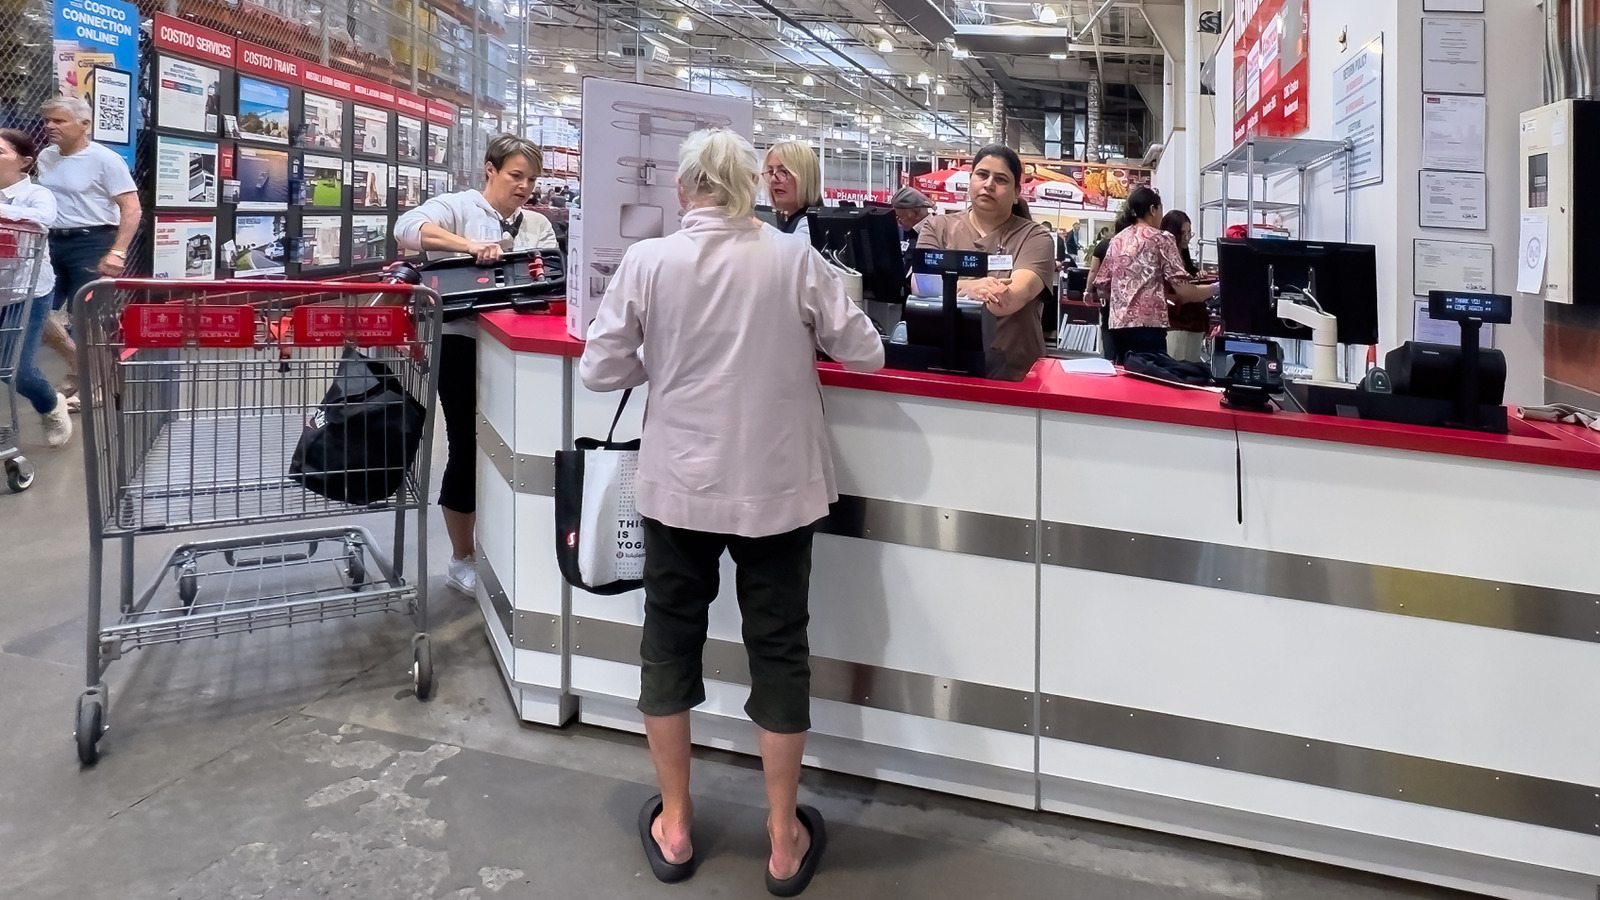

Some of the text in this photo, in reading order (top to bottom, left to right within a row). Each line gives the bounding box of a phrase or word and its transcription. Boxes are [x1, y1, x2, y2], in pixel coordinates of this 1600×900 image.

[84, 0, 126, 20] COSTCO
[62, 8, 132, 36] CONNECTION
[76, 26, 119, 46] ONLINE!
[161, 26, 232, 59] COSTCO SERVICES
[244, 50, 298, 76] COSTCO TRAVEL
[837, 191, 878, 202] PHARMACY
